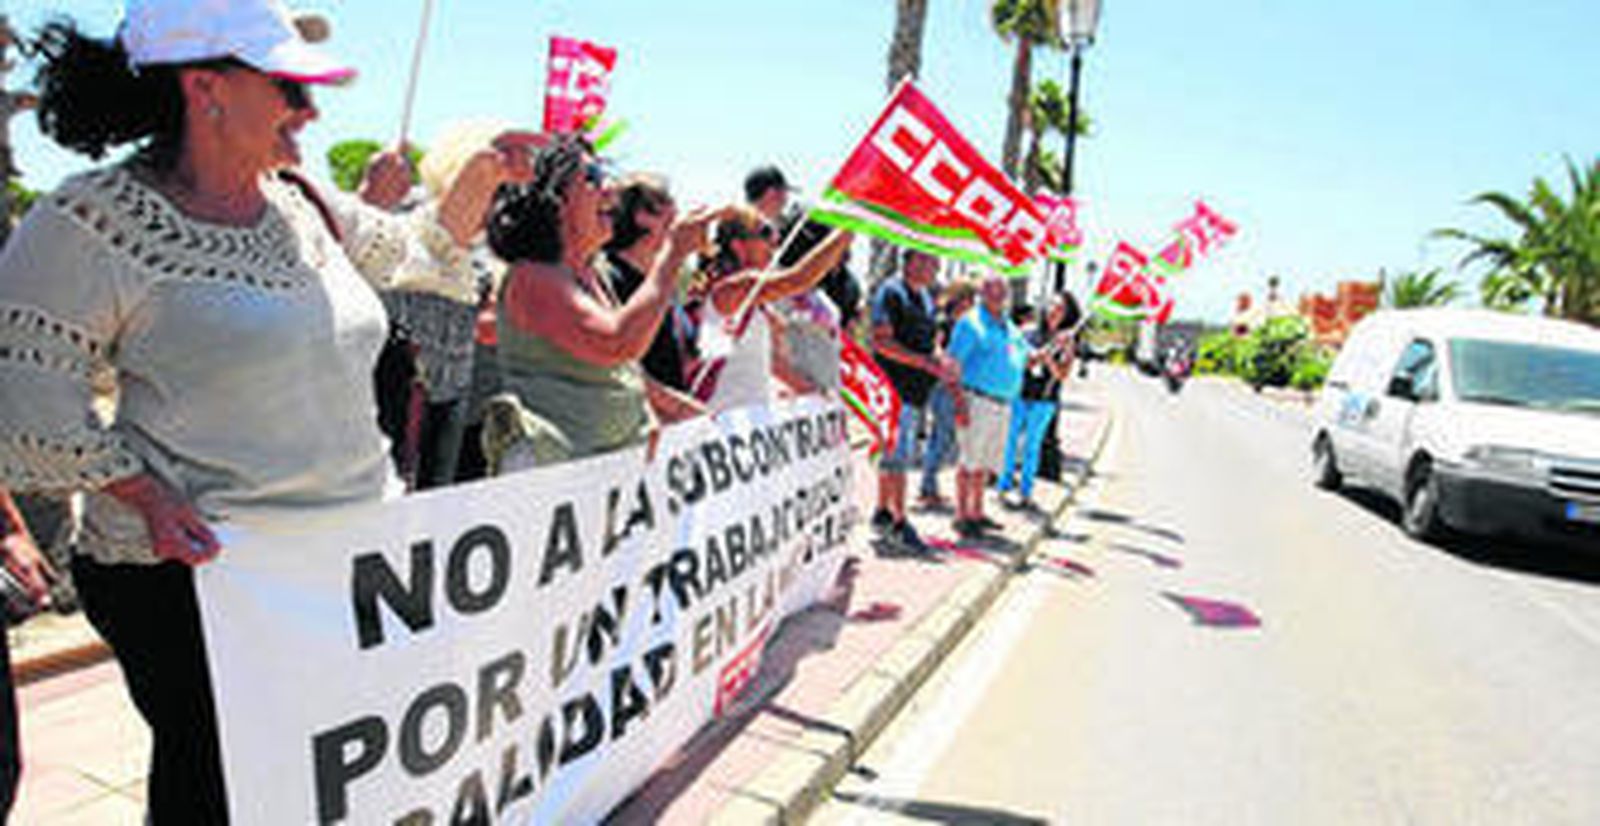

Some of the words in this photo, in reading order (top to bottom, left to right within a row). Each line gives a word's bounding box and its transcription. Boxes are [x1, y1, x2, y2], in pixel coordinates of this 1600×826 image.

[352, 522, 511, 649] NO
[538, 501, 584, 587] A
[602, 478, 655, 556] LA
[311, 650, 526, 825] POR
[552, 585, 627, 687] UN
[393, 643, 676, 826] ALIDAD
[692, 596, 736, 674] EN
